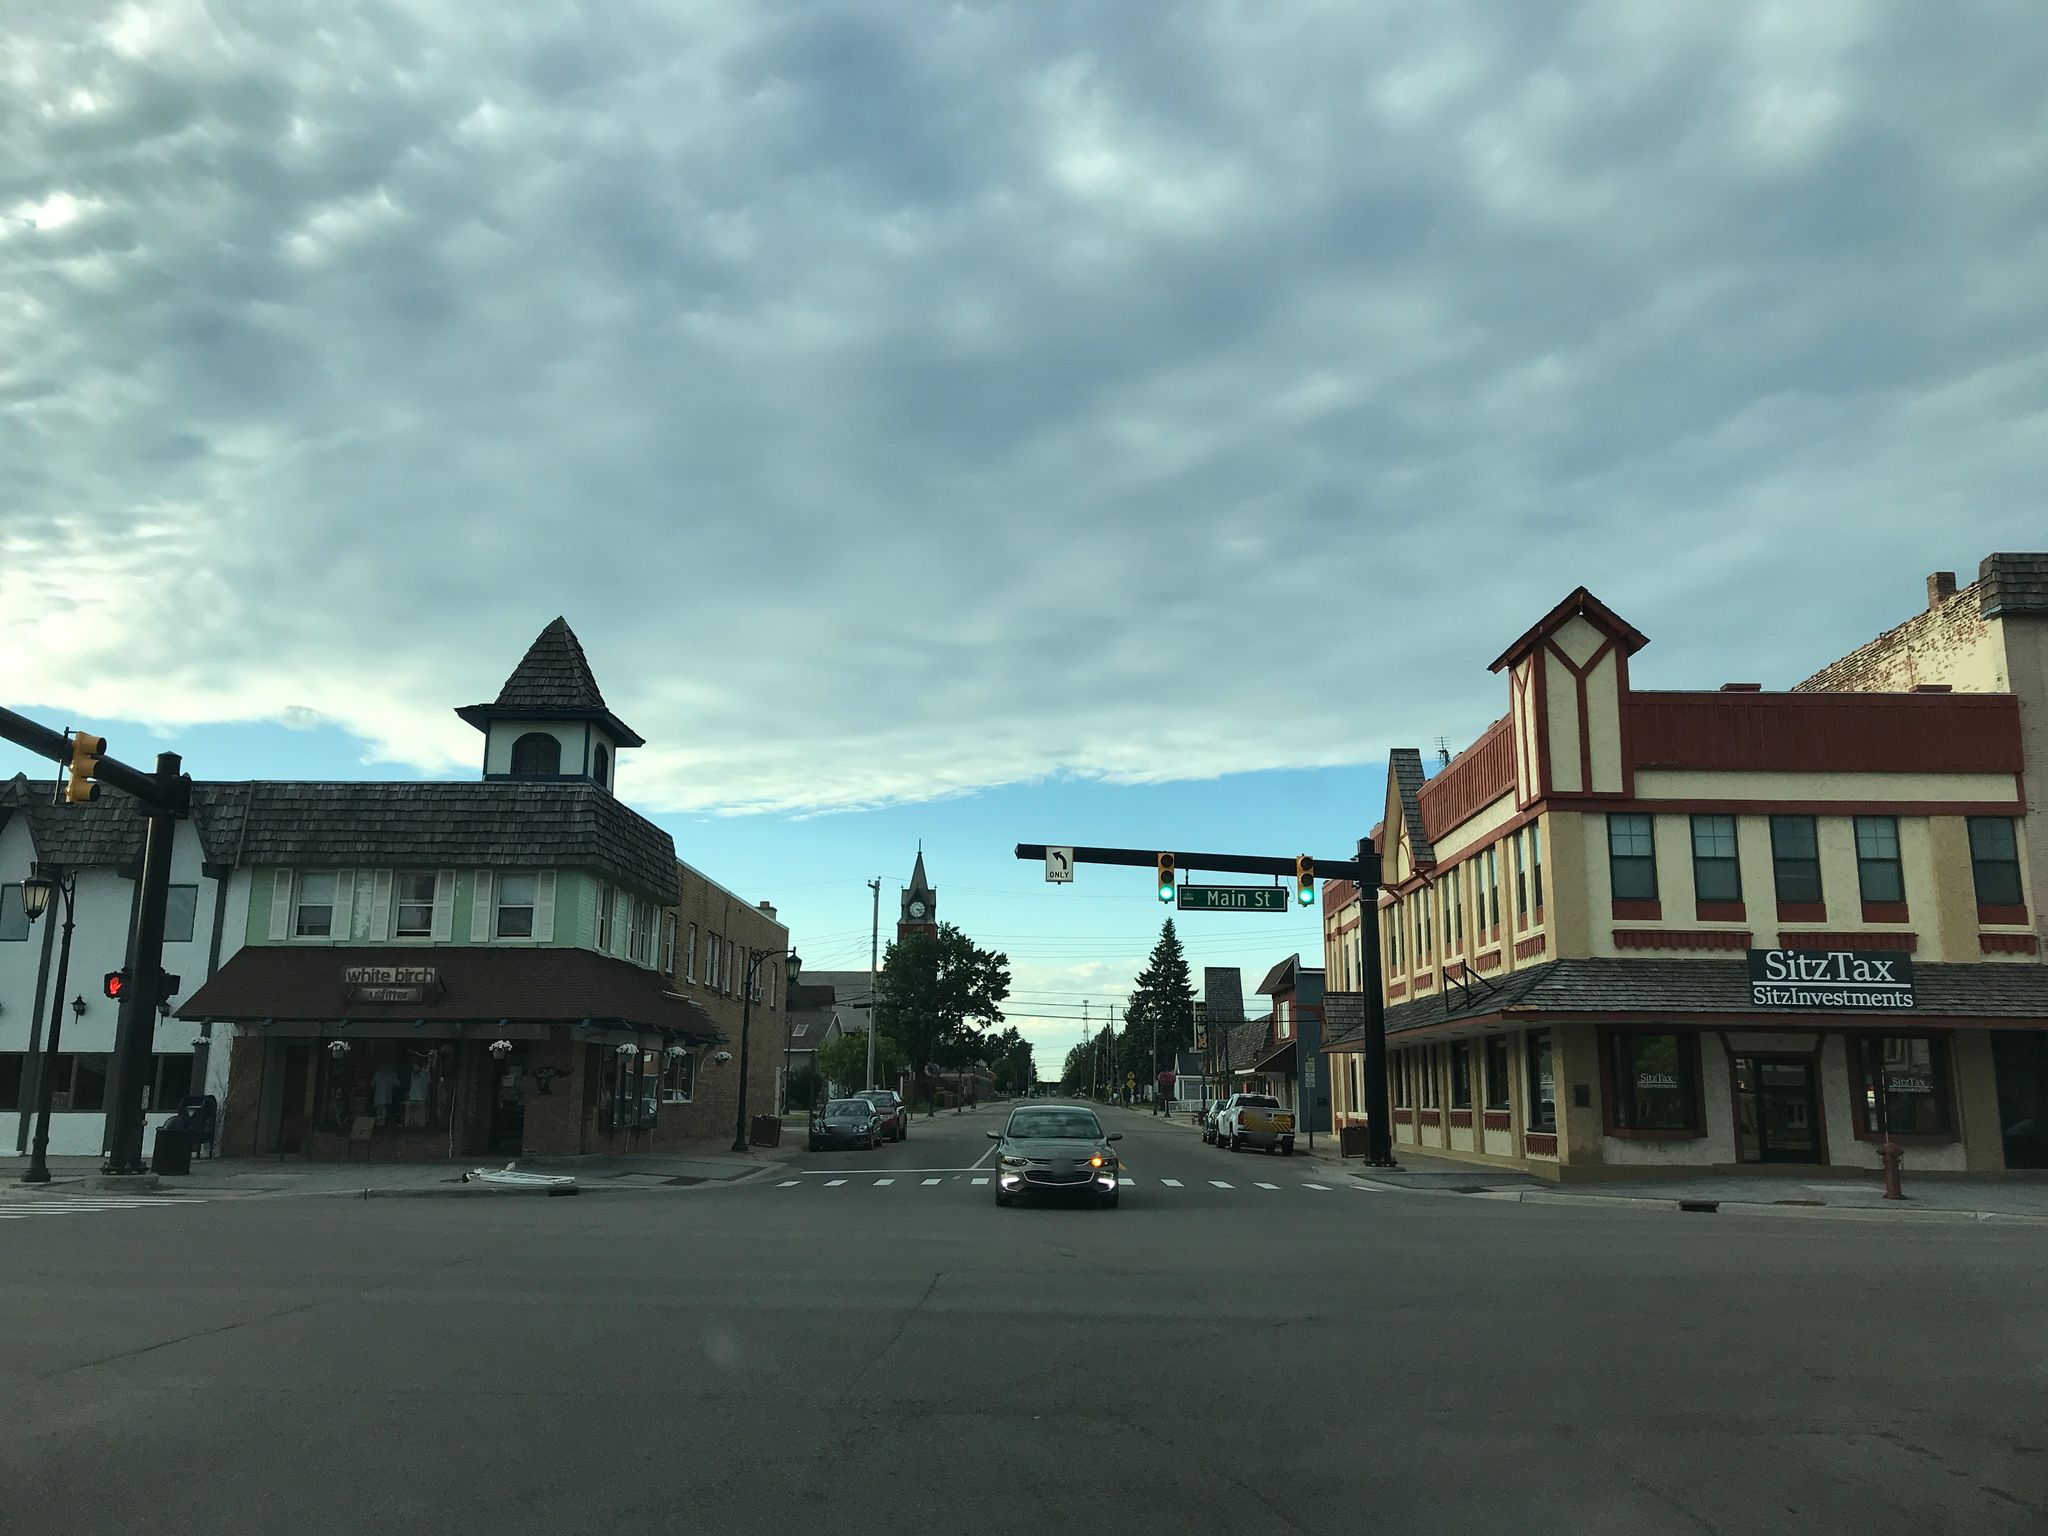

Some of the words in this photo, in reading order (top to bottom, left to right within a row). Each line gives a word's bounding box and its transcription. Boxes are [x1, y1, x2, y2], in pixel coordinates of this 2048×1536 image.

[1049, 871, 1070, 879] ONLY
[1207, 890, 1246, 906] Main
[1254, 891, 1271, 907] St
[1765, 950, 1896, 982] SitzTax
[347, 967, 391, 983] white
[395, 967, 434, 983] birch
[1753, 986, 1914, 1008] SitzInvestments
